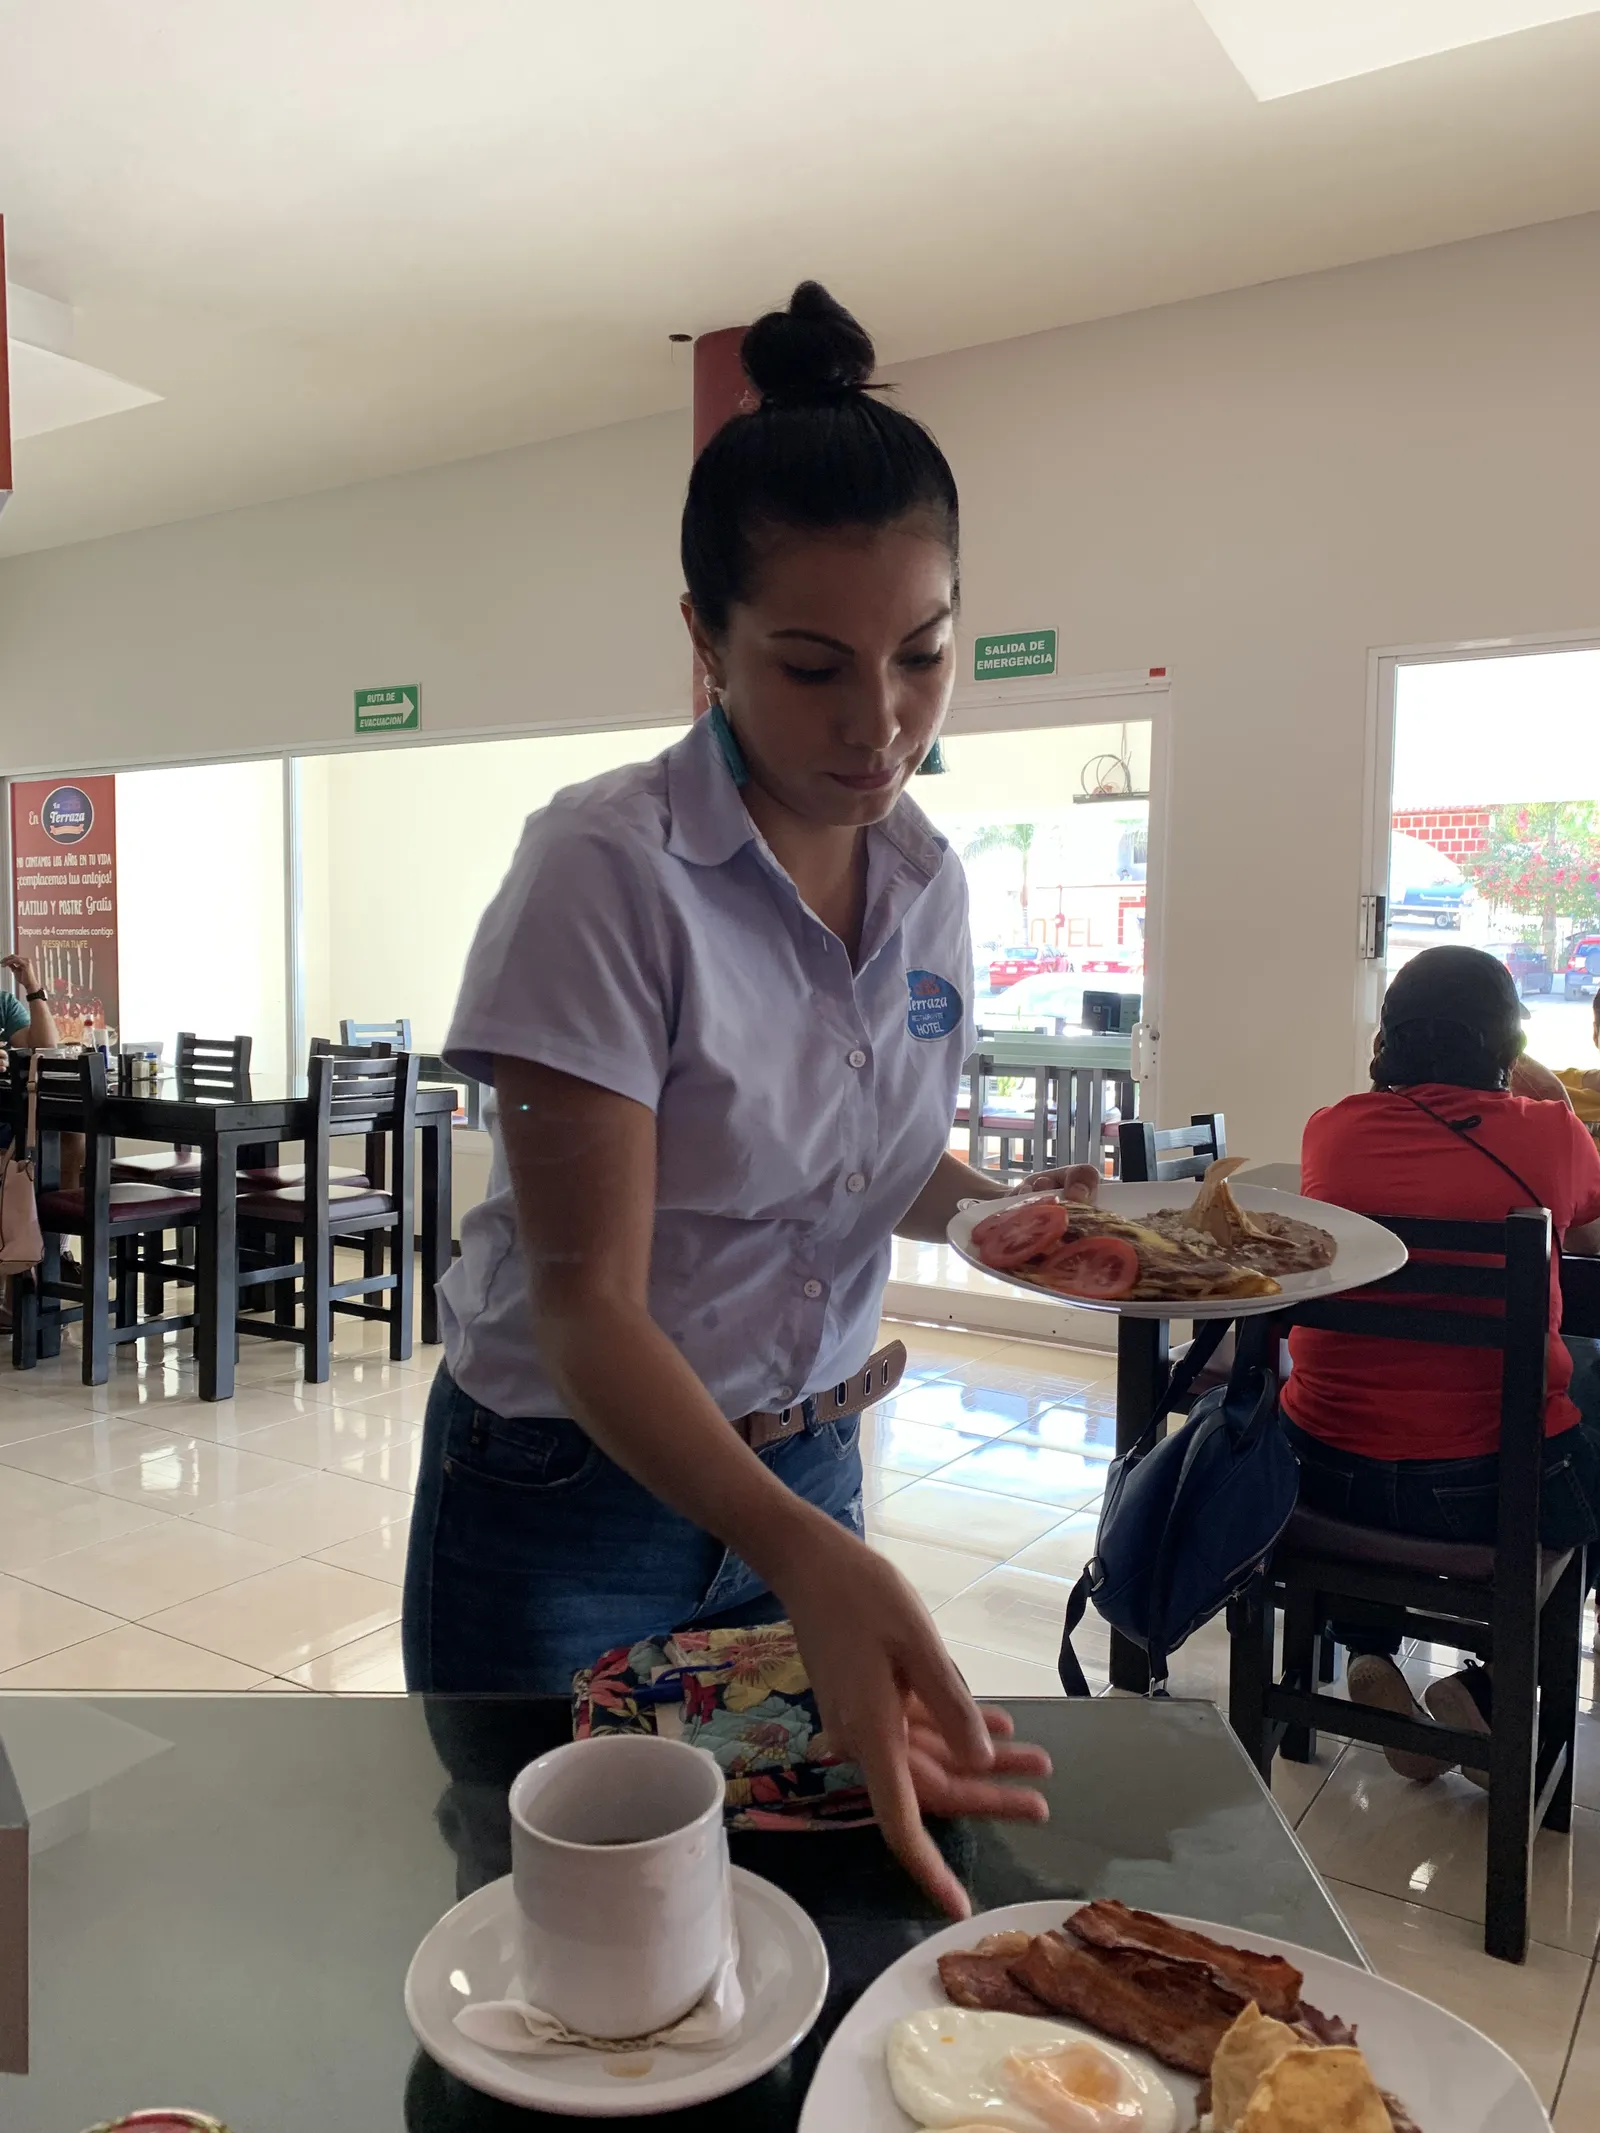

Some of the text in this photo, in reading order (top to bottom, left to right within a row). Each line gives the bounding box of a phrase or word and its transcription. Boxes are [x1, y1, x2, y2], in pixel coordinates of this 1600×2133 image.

[985, 640, 1045, 655] SALIDA DE
[977, 653, 1053, 670] EMERGENCIA
[367, 692, 396, 703] RUTA DE
[50, 811, 85, 824] Terraza
[25, 856, 51, 868] CONTAMOS
[64, 852, 78, 866] AÑOS
[89, 854, 96, 865] TU
[97, 853, 112, 865] VIDA
[69, 872, 80, 884] tus
[18, 896, 112, 915] PLATILLO Y POSTRE Gratis
[43, 926, 50, 935] de
[51, 926, 55, 935] 4
[56, 926, 90, 935] comensales
[91, 926, 114, 938] contigo
[916, 1021, 944, 1036] HOTEL
